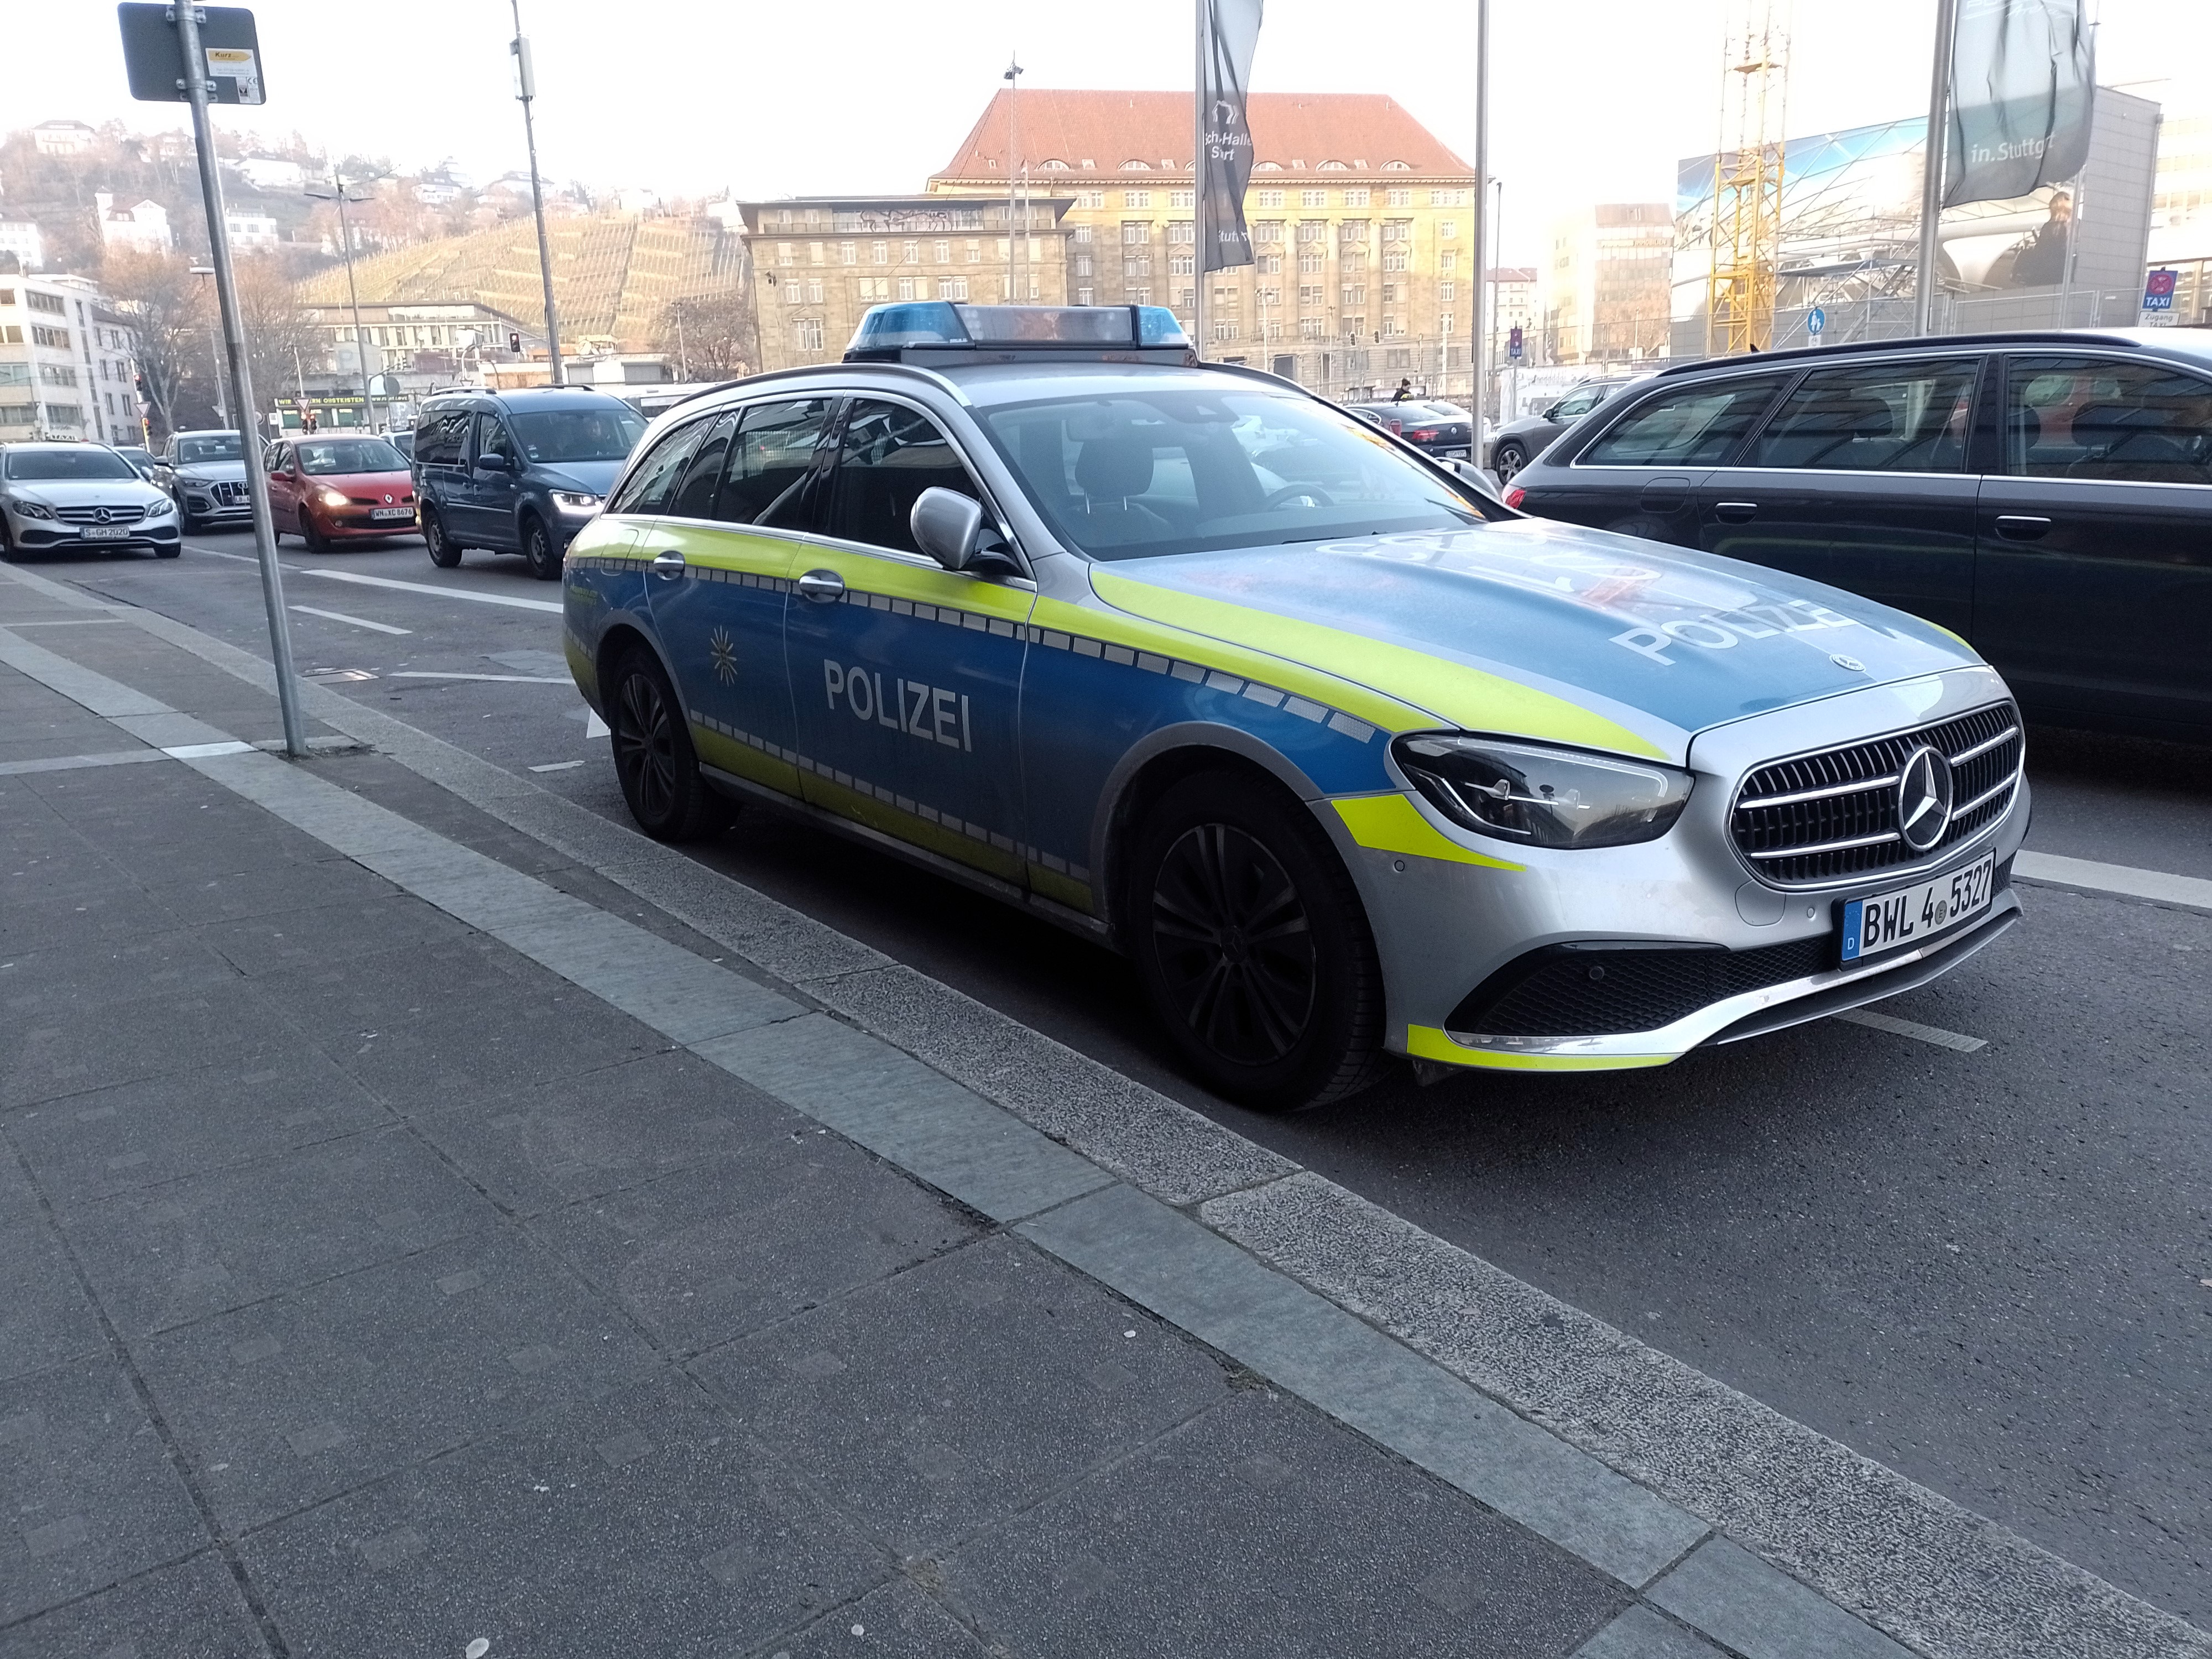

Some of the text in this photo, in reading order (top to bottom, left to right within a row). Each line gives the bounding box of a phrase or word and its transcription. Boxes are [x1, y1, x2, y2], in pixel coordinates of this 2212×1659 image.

[2145, 313, 2173, 322] Zugang
[2146, 297, 2170, 306] TAXI
[1608, 599, 1859, 666] POLIZE
[824, 659, 972, 752] POLIZEI
[1847, 859, 1991, 950] D BWL 4 5327
